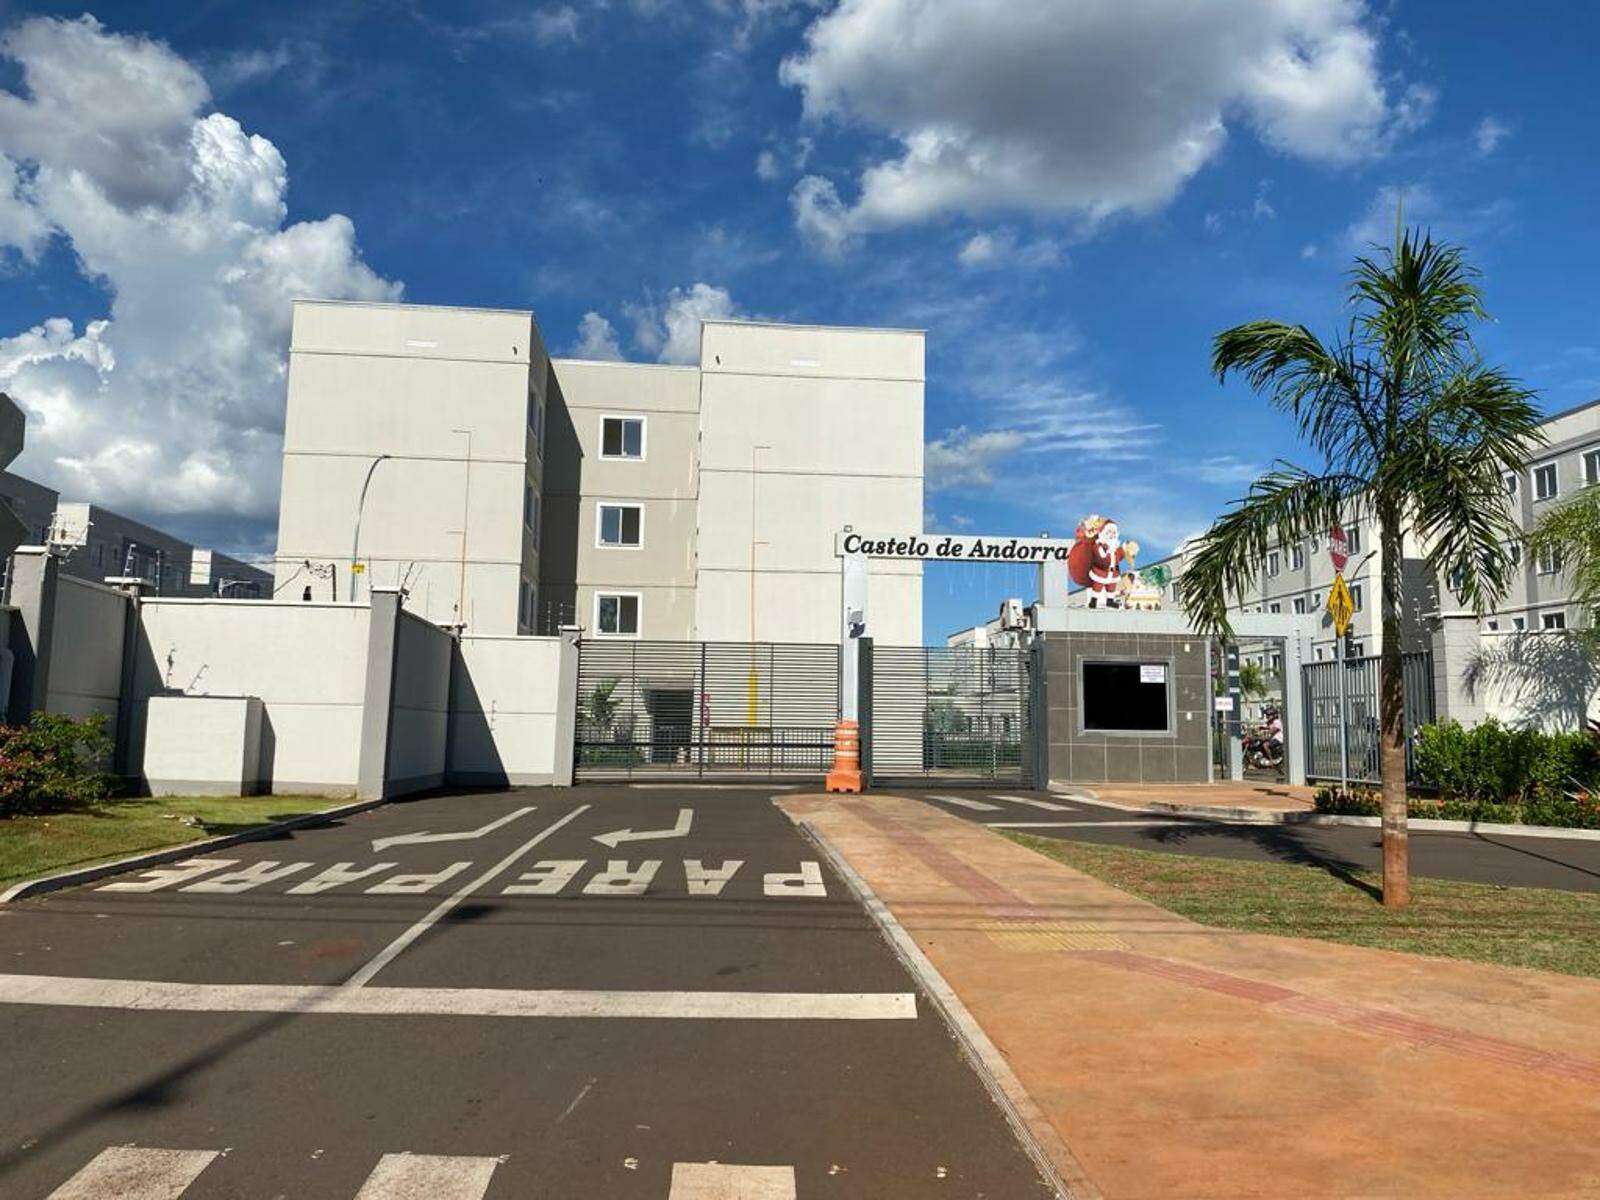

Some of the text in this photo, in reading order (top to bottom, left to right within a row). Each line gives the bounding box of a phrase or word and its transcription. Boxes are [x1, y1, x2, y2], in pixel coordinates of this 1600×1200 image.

[843, 534, 1070, 560] Castelo de Andorra
[94, 858, 473, 895] PARE
[500, 859, 828, 897] PARE
